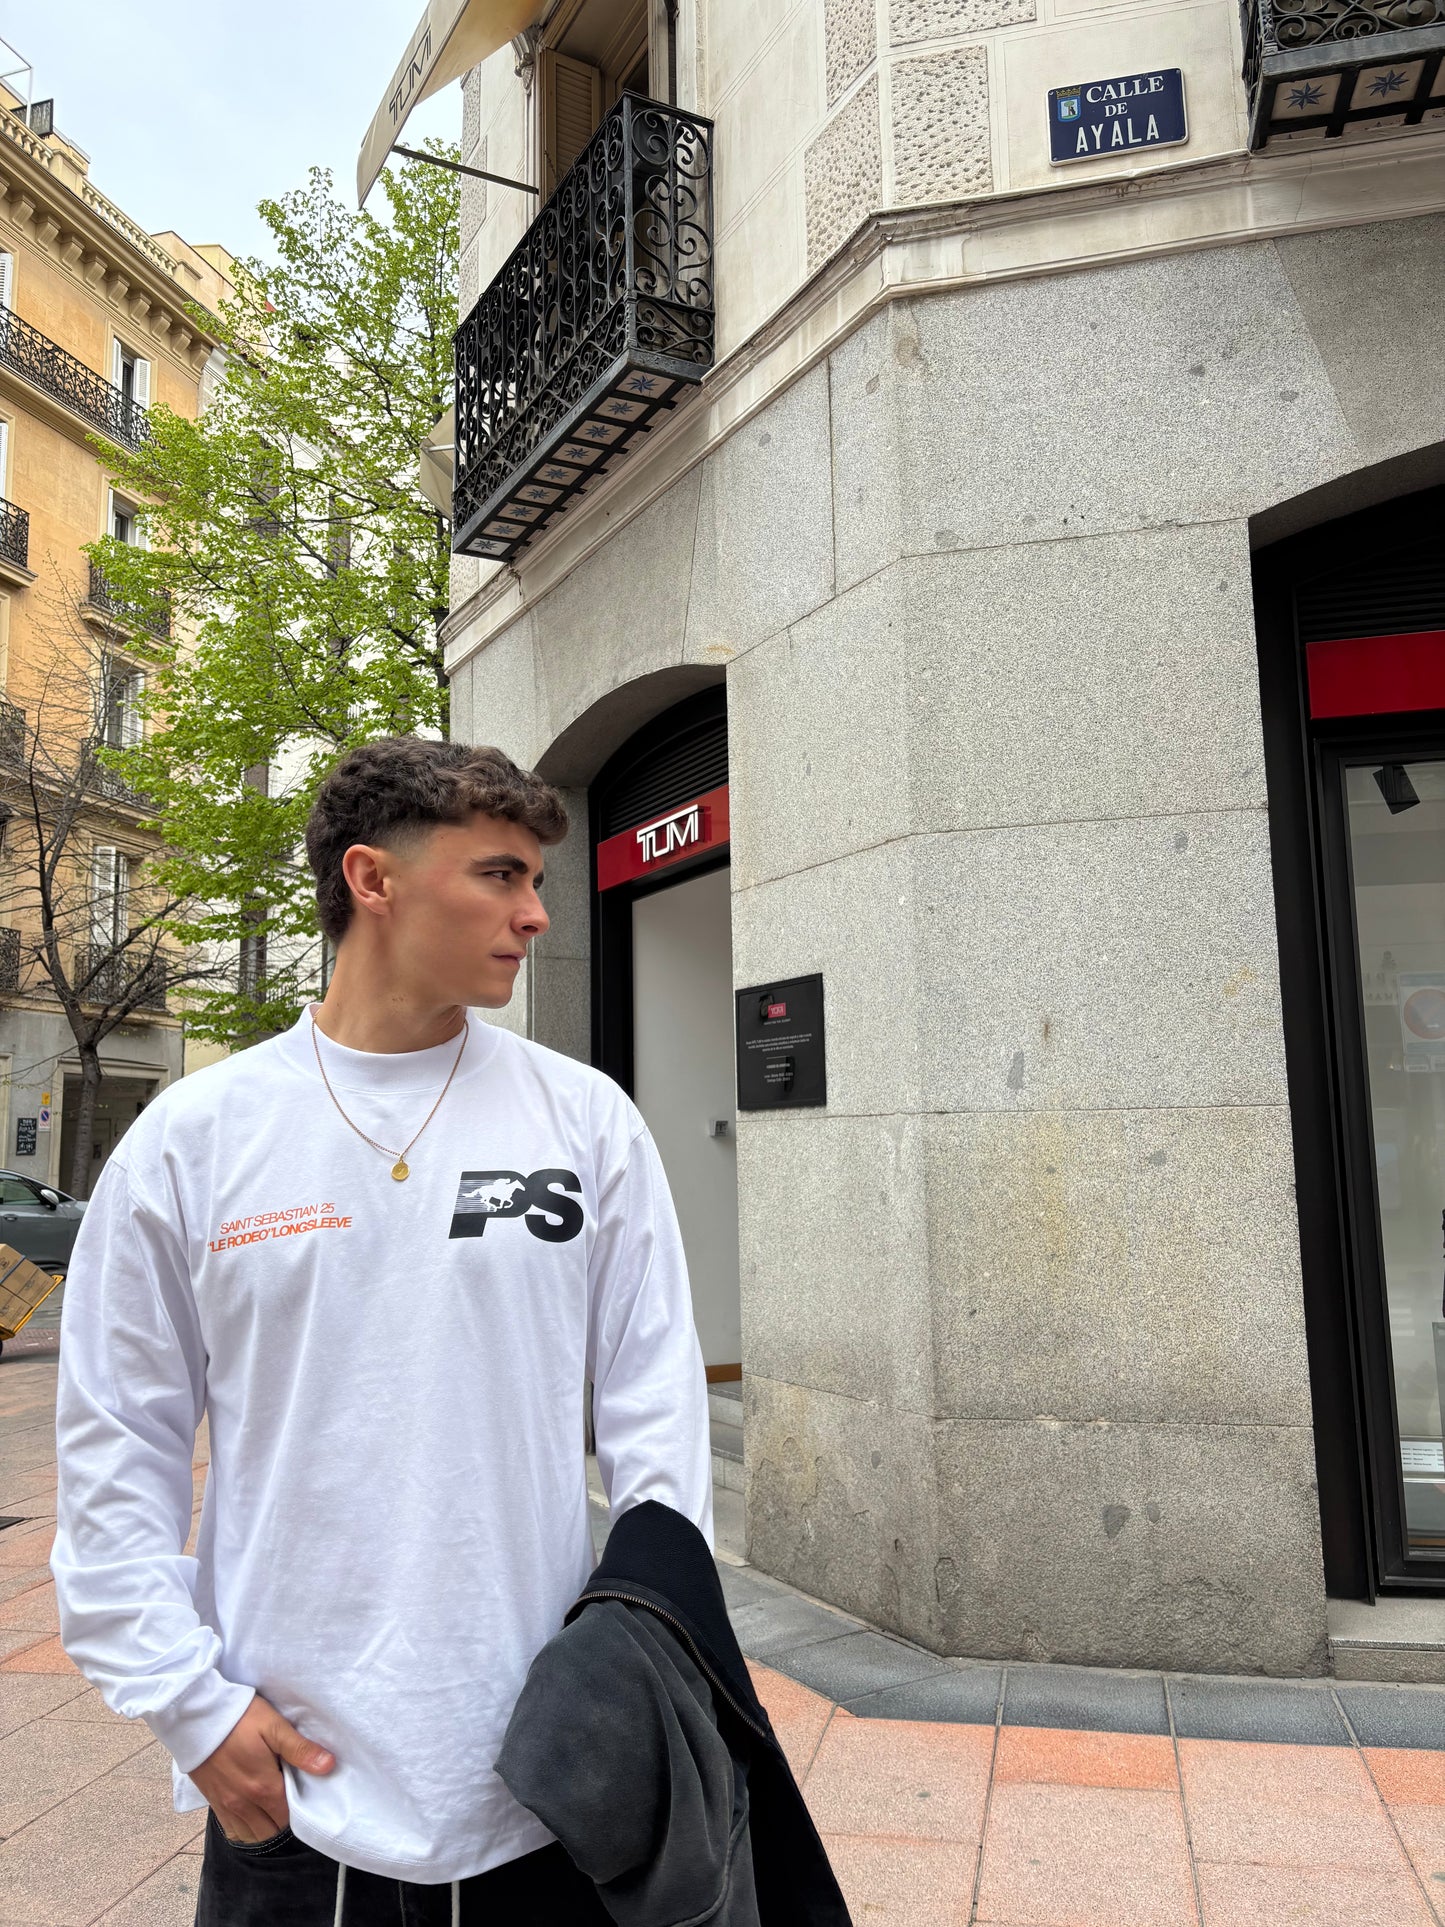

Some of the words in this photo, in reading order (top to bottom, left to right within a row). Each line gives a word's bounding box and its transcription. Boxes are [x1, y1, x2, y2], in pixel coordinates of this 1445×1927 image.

[389, 24, 432, 126] TUMI
[1086, 75, 1165, 103] CALLE
[1104, 102, 1128, 118] DE
[1075, 114, 1160, 154] AYALA
[636, 804, 699, 863] TUMI
[220, 1216, 253, 1235] SAINT
[253, 1204, 319, 1227] SEBASTIAN
[320, 1202, 336, 1214] 25
[448, 1168, 584, 1243] PS
